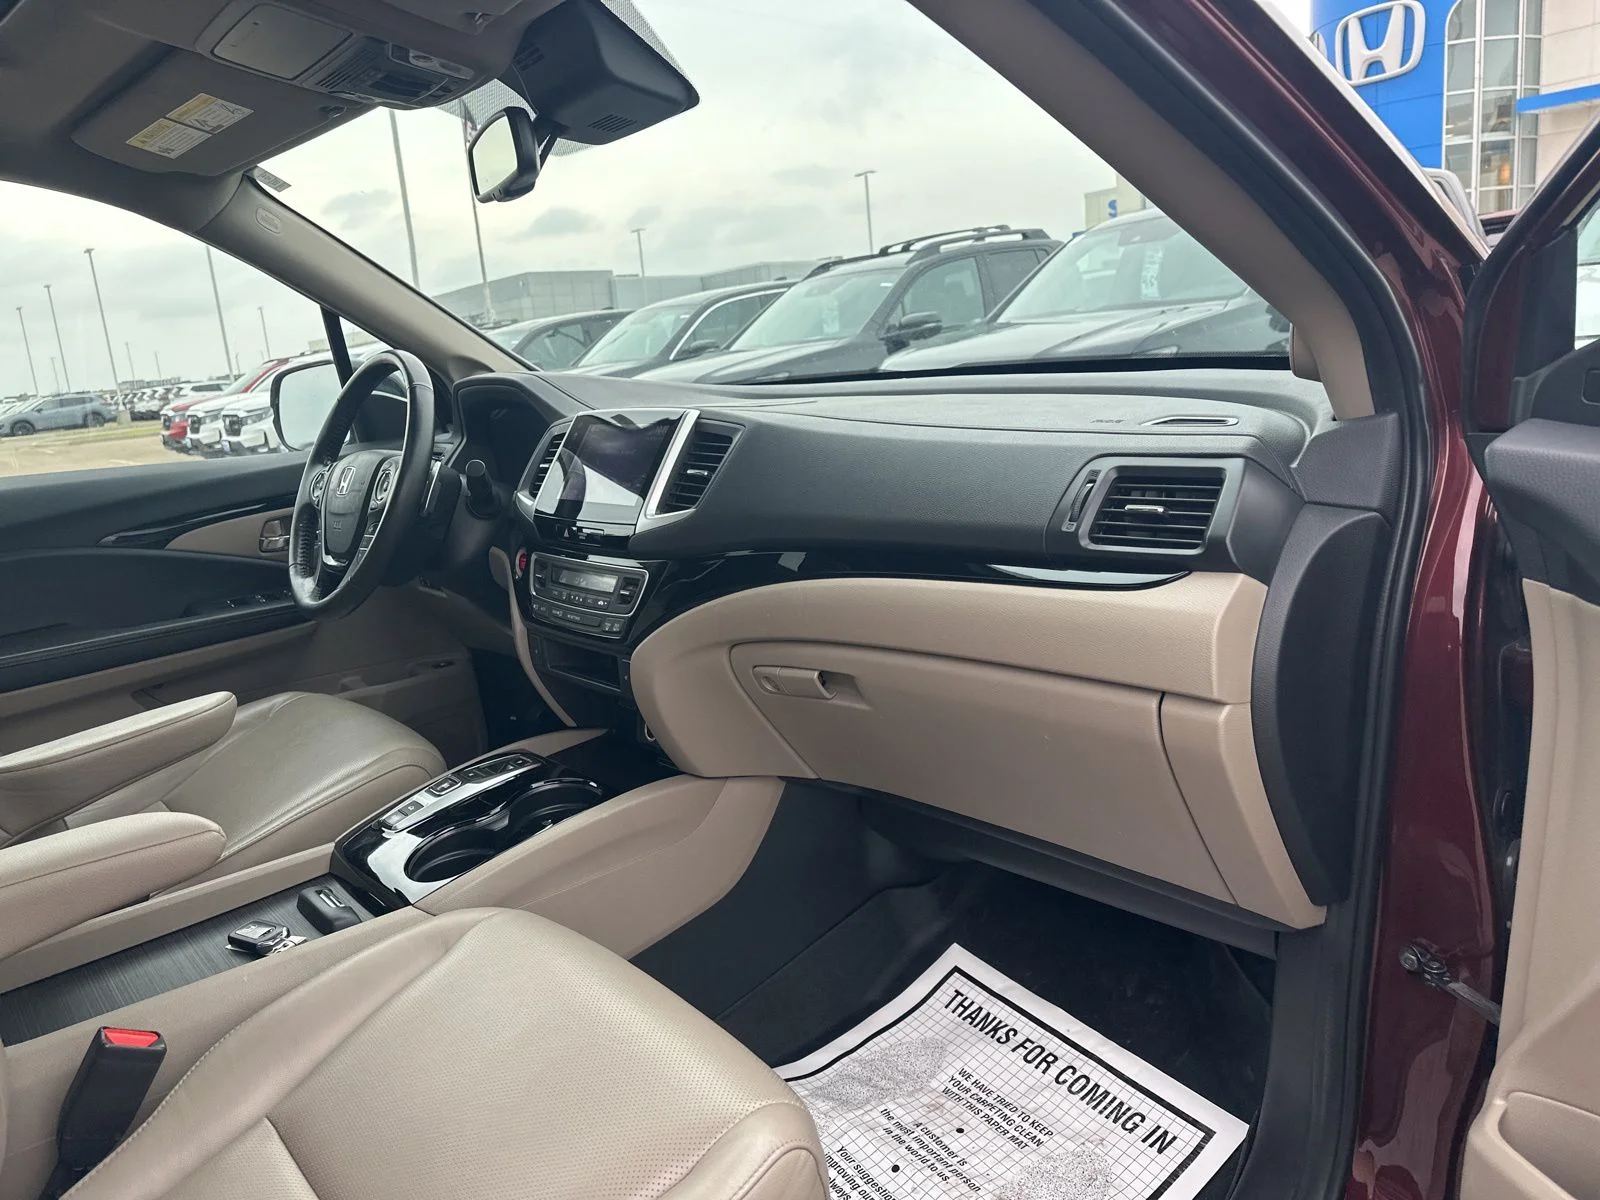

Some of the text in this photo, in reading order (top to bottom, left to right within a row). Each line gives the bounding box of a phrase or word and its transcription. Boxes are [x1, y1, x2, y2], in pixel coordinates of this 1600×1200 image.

[944, 989, 1178, 1154] THANKS FOR COMING IN
[941, 1086, 1030, 1150] WITH THIS PAPER MAT
[948, 1075, 1044, 1147] YOUR CARPETING CLEAN
[958, 1068, 1054, 1137] WE HAVE TRIED TO KEEP
[824, 1151, 861, 1191] improving
[837, 1146, 897, 1200] Your suggestio
[880, 1108, 982, 1192] the most important person
[882, 1127, 950, 1184] in the world to us.
[920, 1126, 958, 1159] customer
[957, 1158, 968, 1167] is
[829, 1177, 852, 1200] lways
